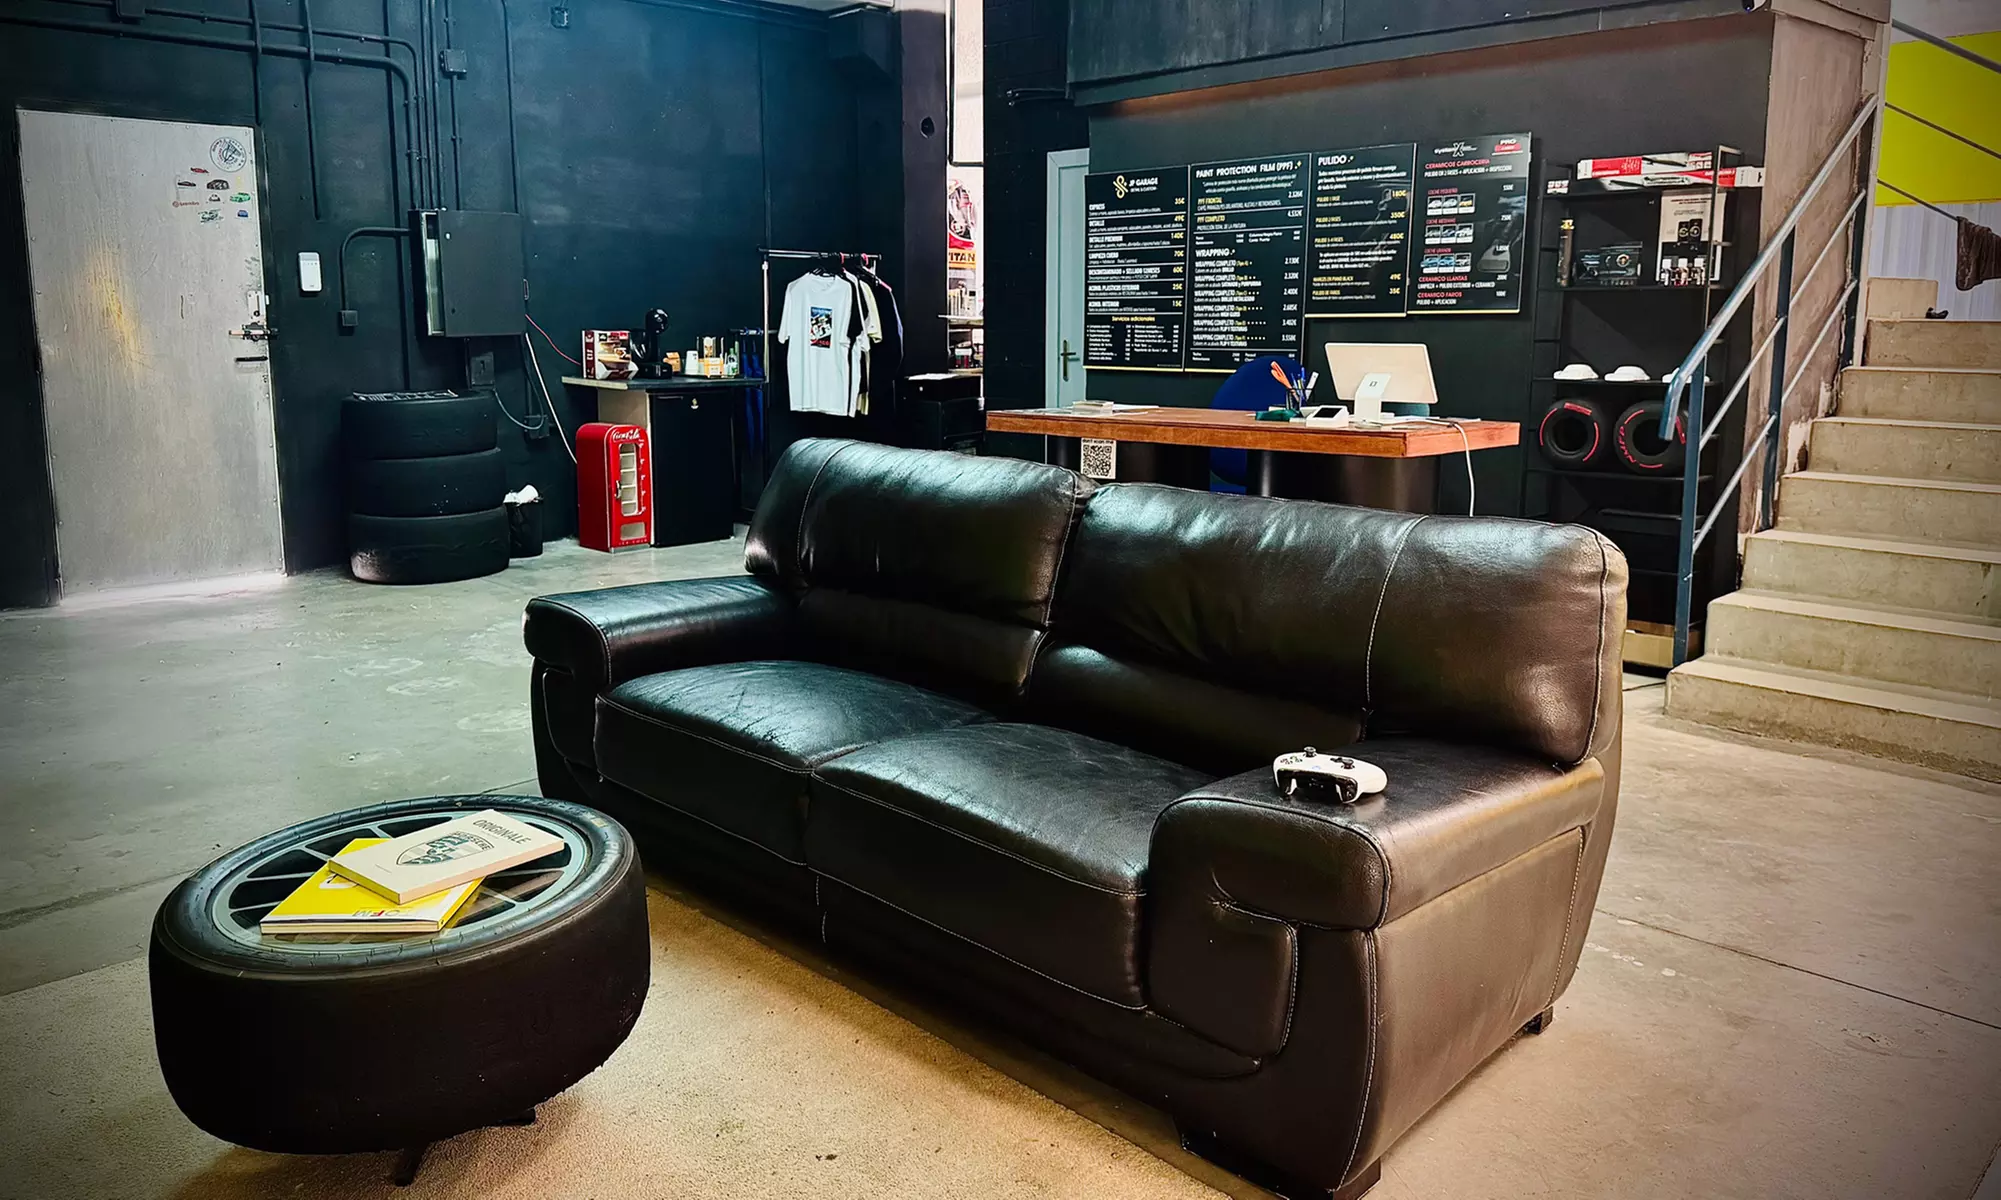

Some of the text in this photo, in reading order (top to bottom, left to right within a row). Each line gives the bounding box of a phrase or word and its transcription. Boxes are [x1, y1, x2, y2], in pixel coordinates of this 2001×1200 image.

[1318, 156, 1346, 166] PULIDO
[1196, 168, 1213, 179] PAINT
[1216, 164, 1257, 177] PROTECTION
[1260, 163, 1275, 173] FILM
[1136, 178, 1158, 187] GARAGE
[949, 252, 976, 262] ITAN
[1195, 249, 1229, 258] WRAPPING
[473, 820, 532, 846] ORIGINALE
[456, 831, 492, 851] PORSCHE
